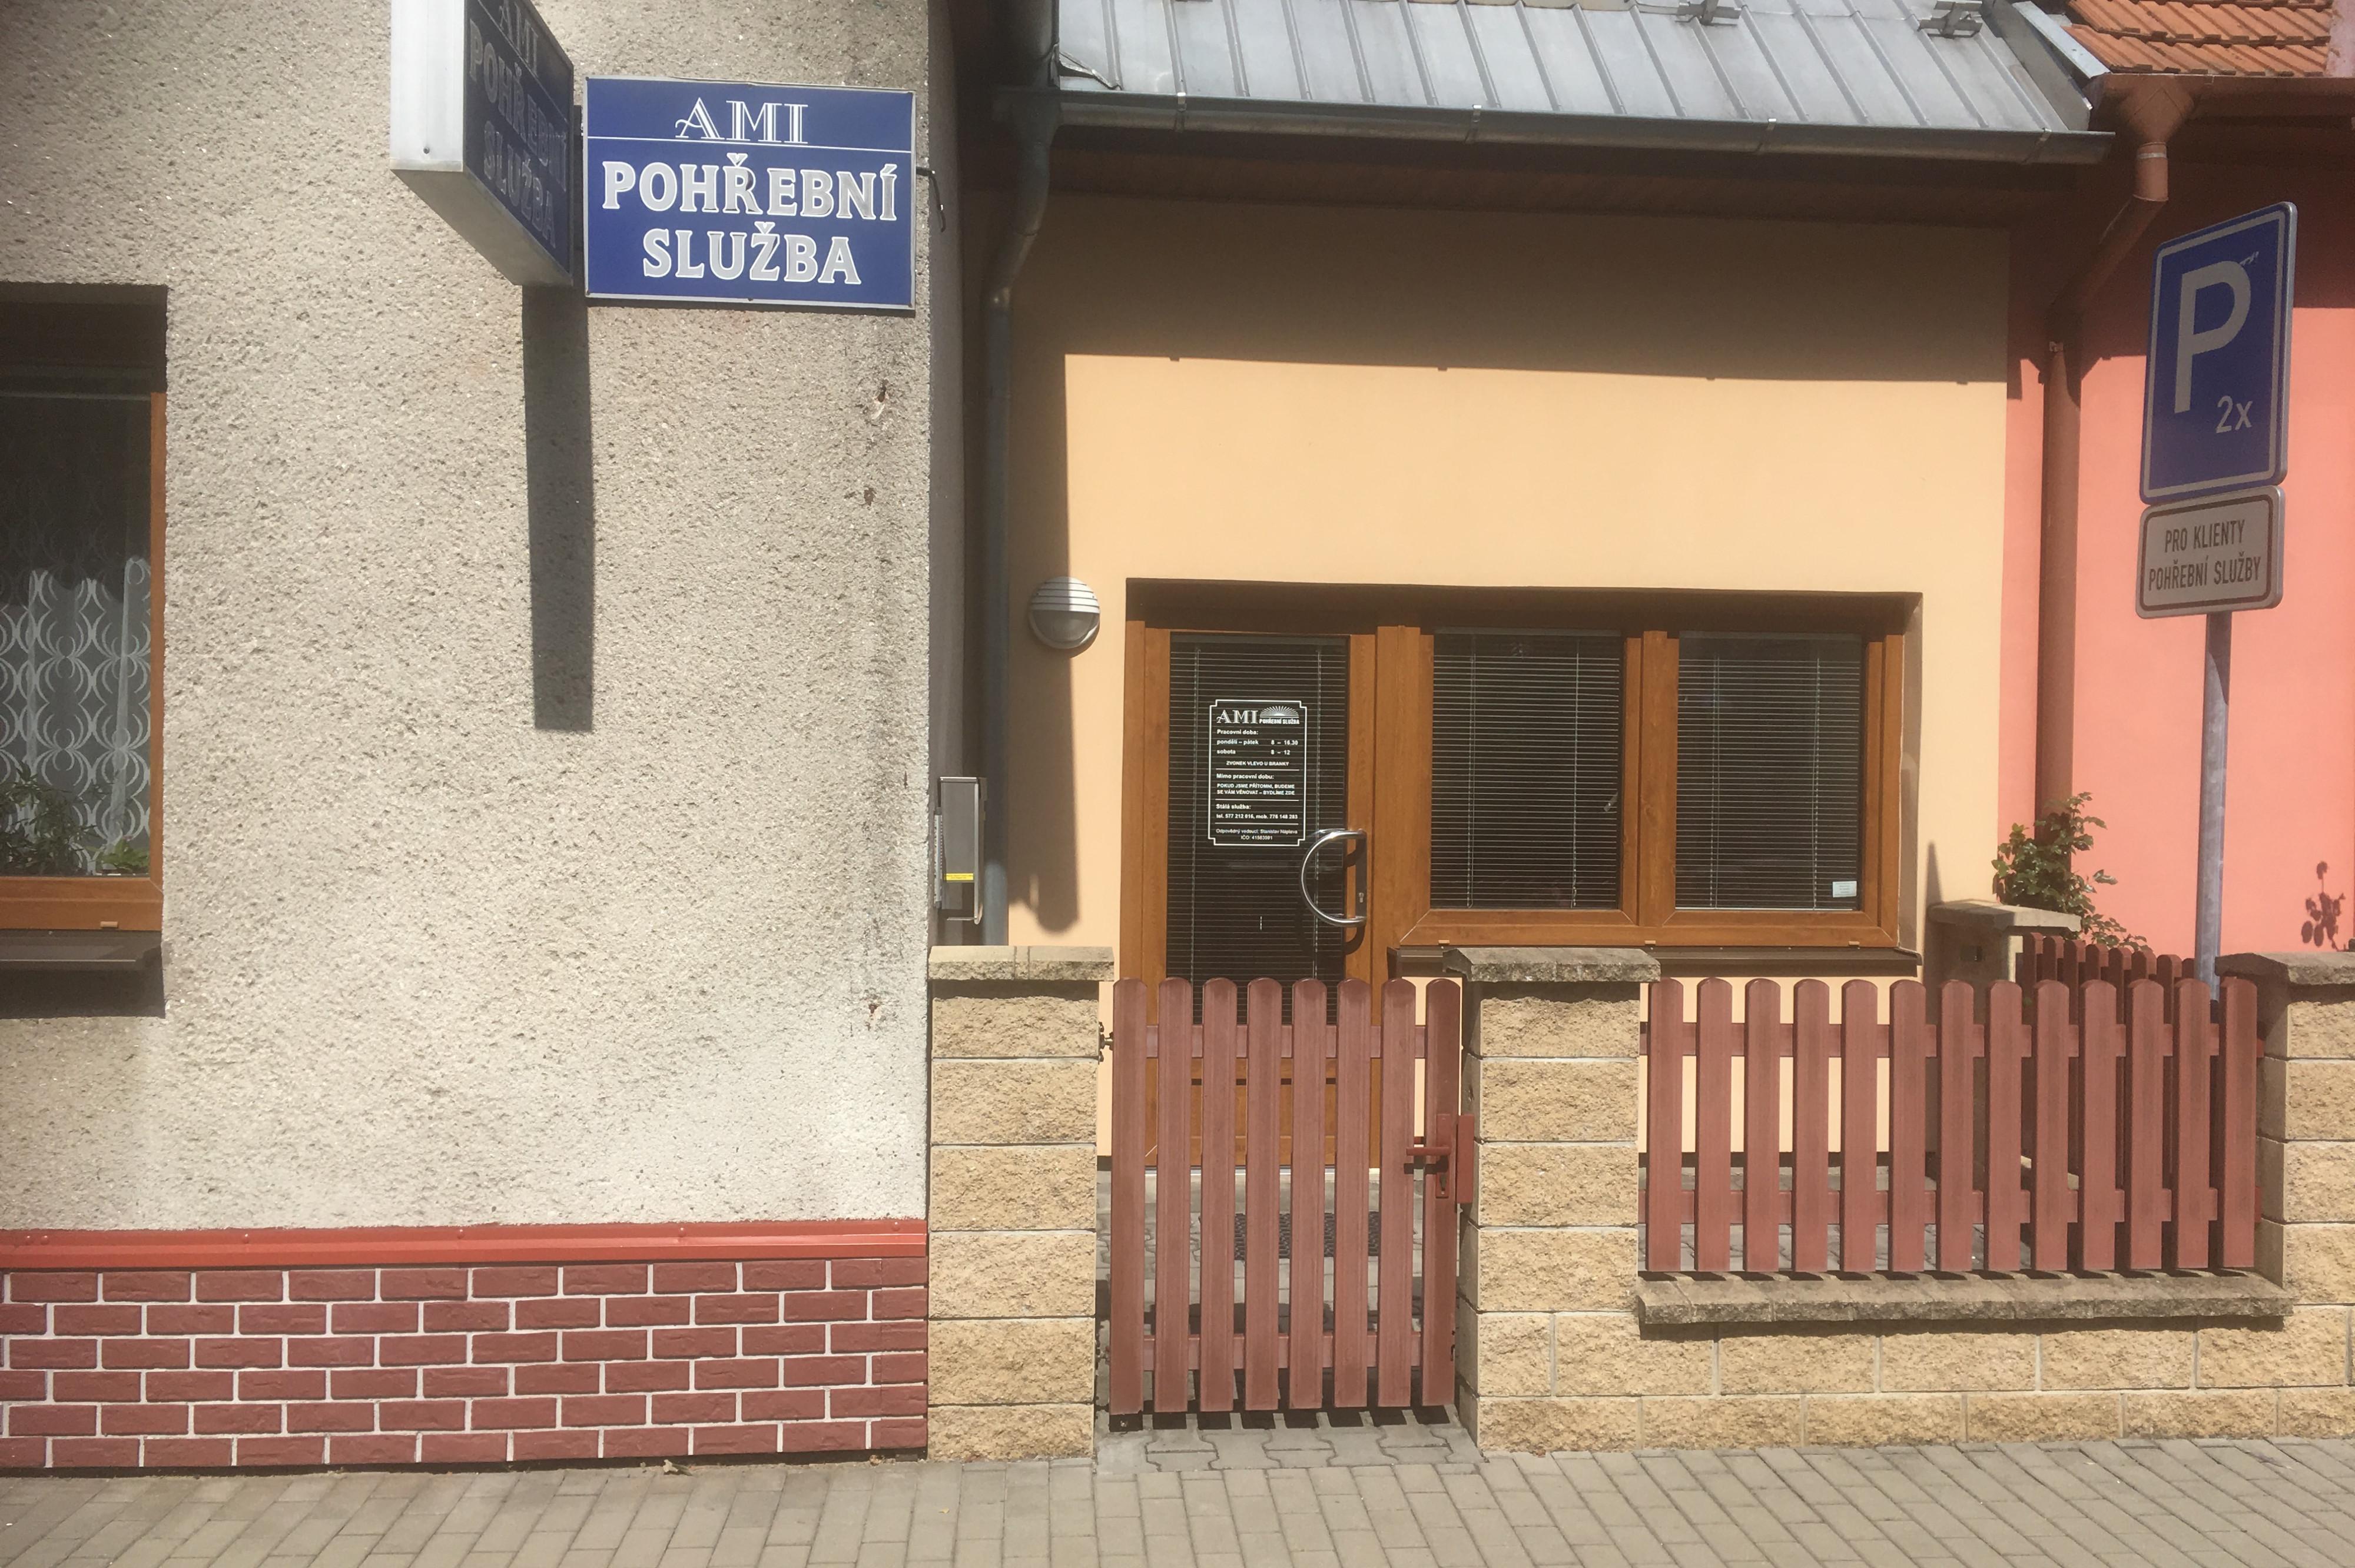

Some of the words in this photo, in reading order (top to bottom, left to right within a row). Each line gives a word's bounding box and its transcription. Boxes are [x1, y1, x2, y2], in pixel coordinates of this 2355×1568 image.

[675, 97, 809, 144] AMI
[485, 120, 556, 248] SLUŽBA
[602, 152, 897, 221] POHŘEBNÍ
[642, 221, 862, 285] SLUŽBA
[2174, 260, 2251, 413] P
[2215, 395, 2254, 433] 2x
[2165, 528, 2187, 553] PRO
[2193, 519, 2245, 550] KLIENTY
[2149, 555, 2210, 592] POHŘEBNÍ
[2214, 550, 2261, 585] SLUŽBY
[1216, 709, 1258, 724] AMI
